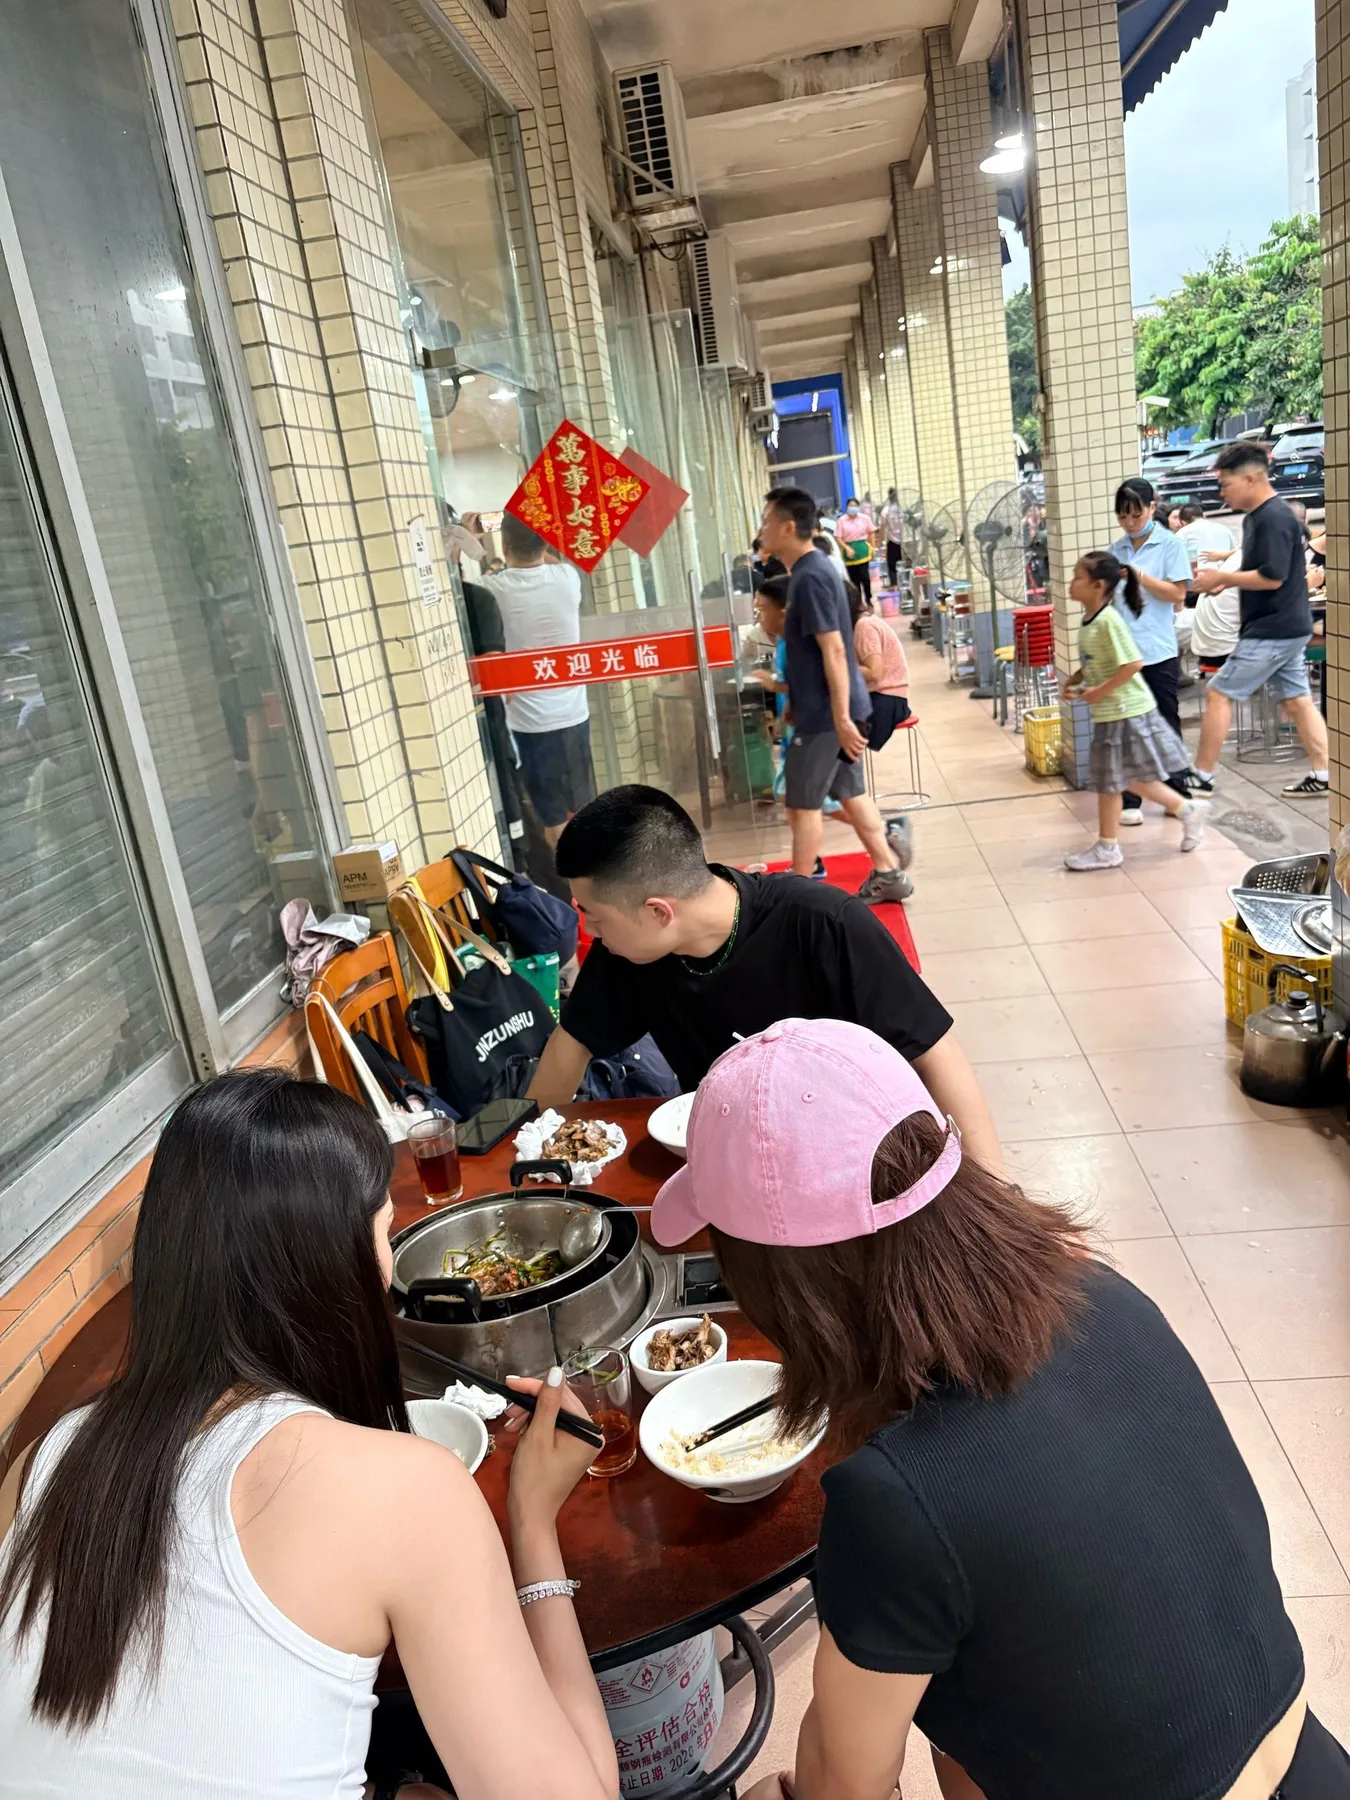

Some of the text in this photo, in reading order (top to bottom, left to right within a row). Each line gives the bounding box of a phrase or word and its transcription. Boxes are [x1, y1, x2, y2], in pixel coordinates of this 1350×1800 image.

[555, 432, 600, 559] 萬事如意
[532, 644, 660, 682] 欢迎光临
[343, 872, 368, 884] APM
